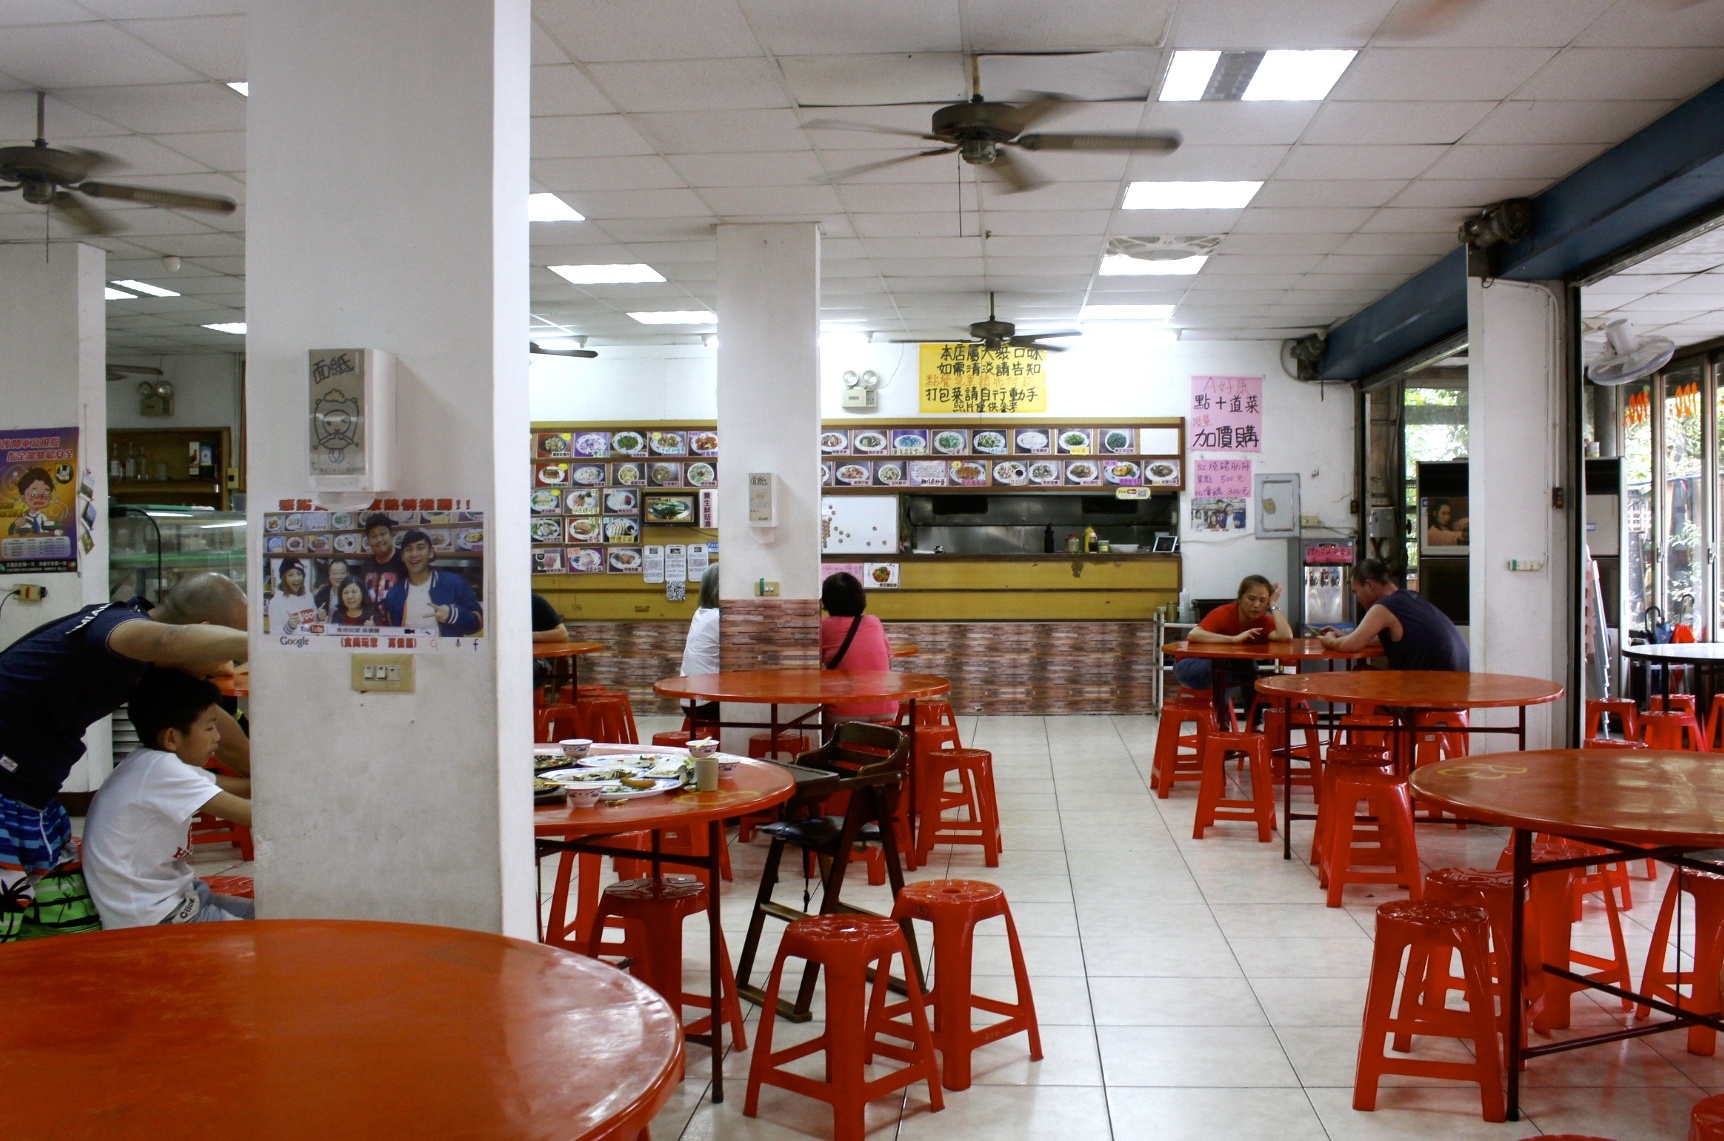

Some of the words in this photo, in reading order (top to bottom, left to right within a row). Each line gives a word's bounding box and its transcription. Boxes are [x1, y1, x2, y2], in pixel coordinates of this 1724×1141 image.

[937, 361, 1041, 376] 如需清淡請告知
[1194, 395, 1260, 413] 點十道菜
[0, 437, 60, 449] 後開車高風險
[1192, 425, 1260, 449] 加價購
[280, 636, 309, 648] Google
